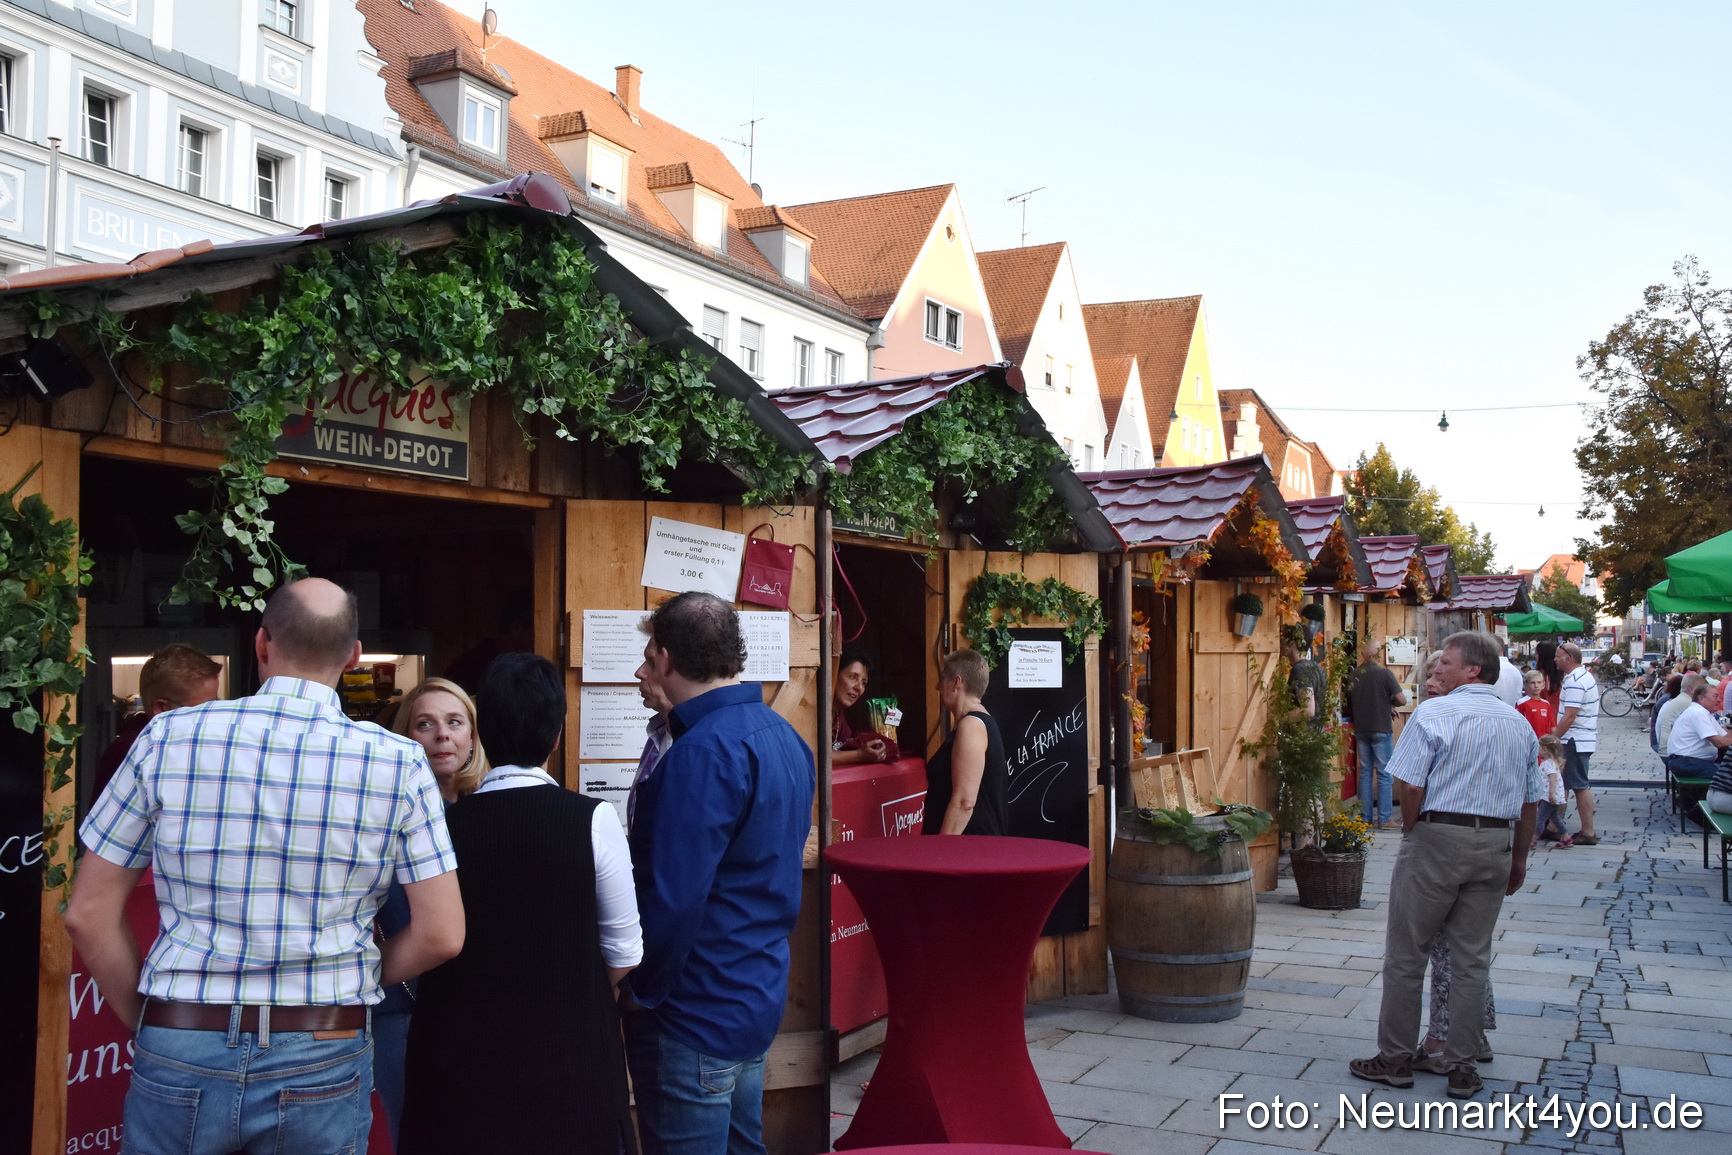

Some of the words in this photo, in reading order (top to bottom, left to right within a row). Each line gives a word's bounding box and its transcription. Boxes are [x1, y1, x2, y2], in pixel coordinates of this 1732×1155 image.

[314, 426, 453, 468] WEIN-DEPOT
[656, 530, 709, 547] Umhängetasche
[710, 541, 721, 549] mit
[721, 543, 736, 552] Glas
[689, 545, 702, 553] und
[664, 549, 684, 558] erster
[684, 552, 710, 564] Füllung
[710, 557, 720, 565] 0,1
[680, 568, 697, 578] 3,00
[698, 571, 704, 579] €
[1018, 745, 1029, 764] LA
